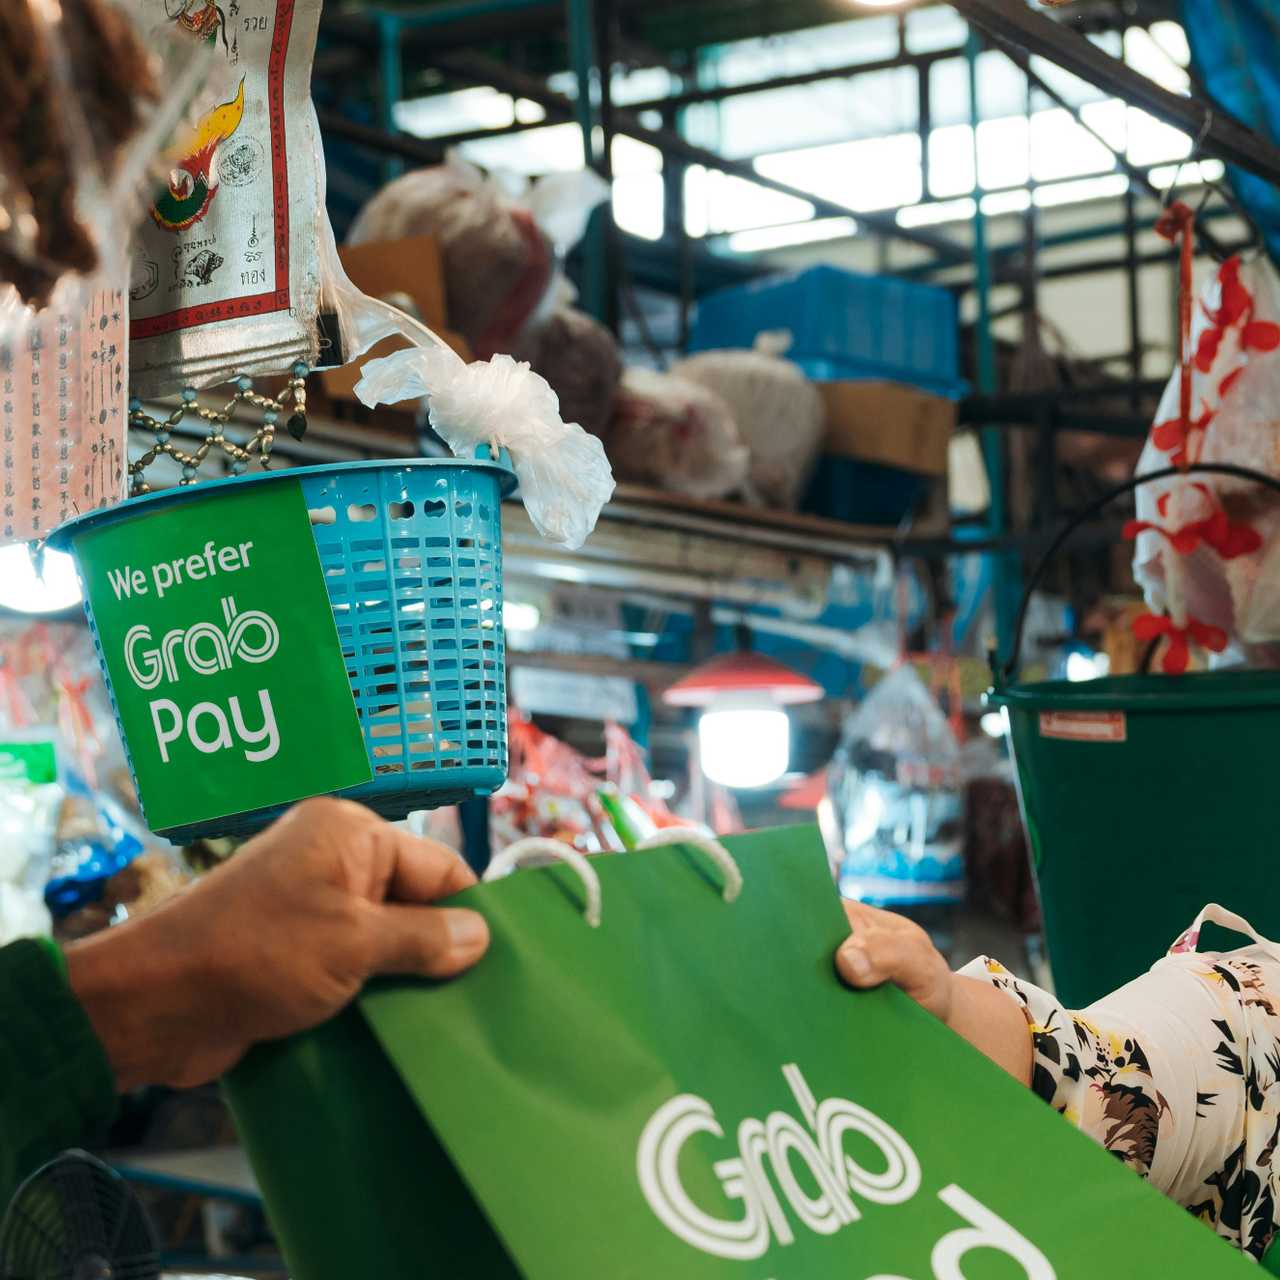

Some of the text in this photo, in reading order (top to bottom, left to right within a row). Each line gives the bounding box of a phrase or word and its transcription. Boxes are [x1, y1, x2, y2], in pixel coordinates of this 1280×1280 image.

[243, 16, 268, 32] รวย
[240, 269, 266, 286] ทอง
[107, 541, 254, 601] We prefer
[124, 596, 280, 690] Grab
[149, 688, 281, 763] Pay
[636, 1063, 922, 1260] Grab
